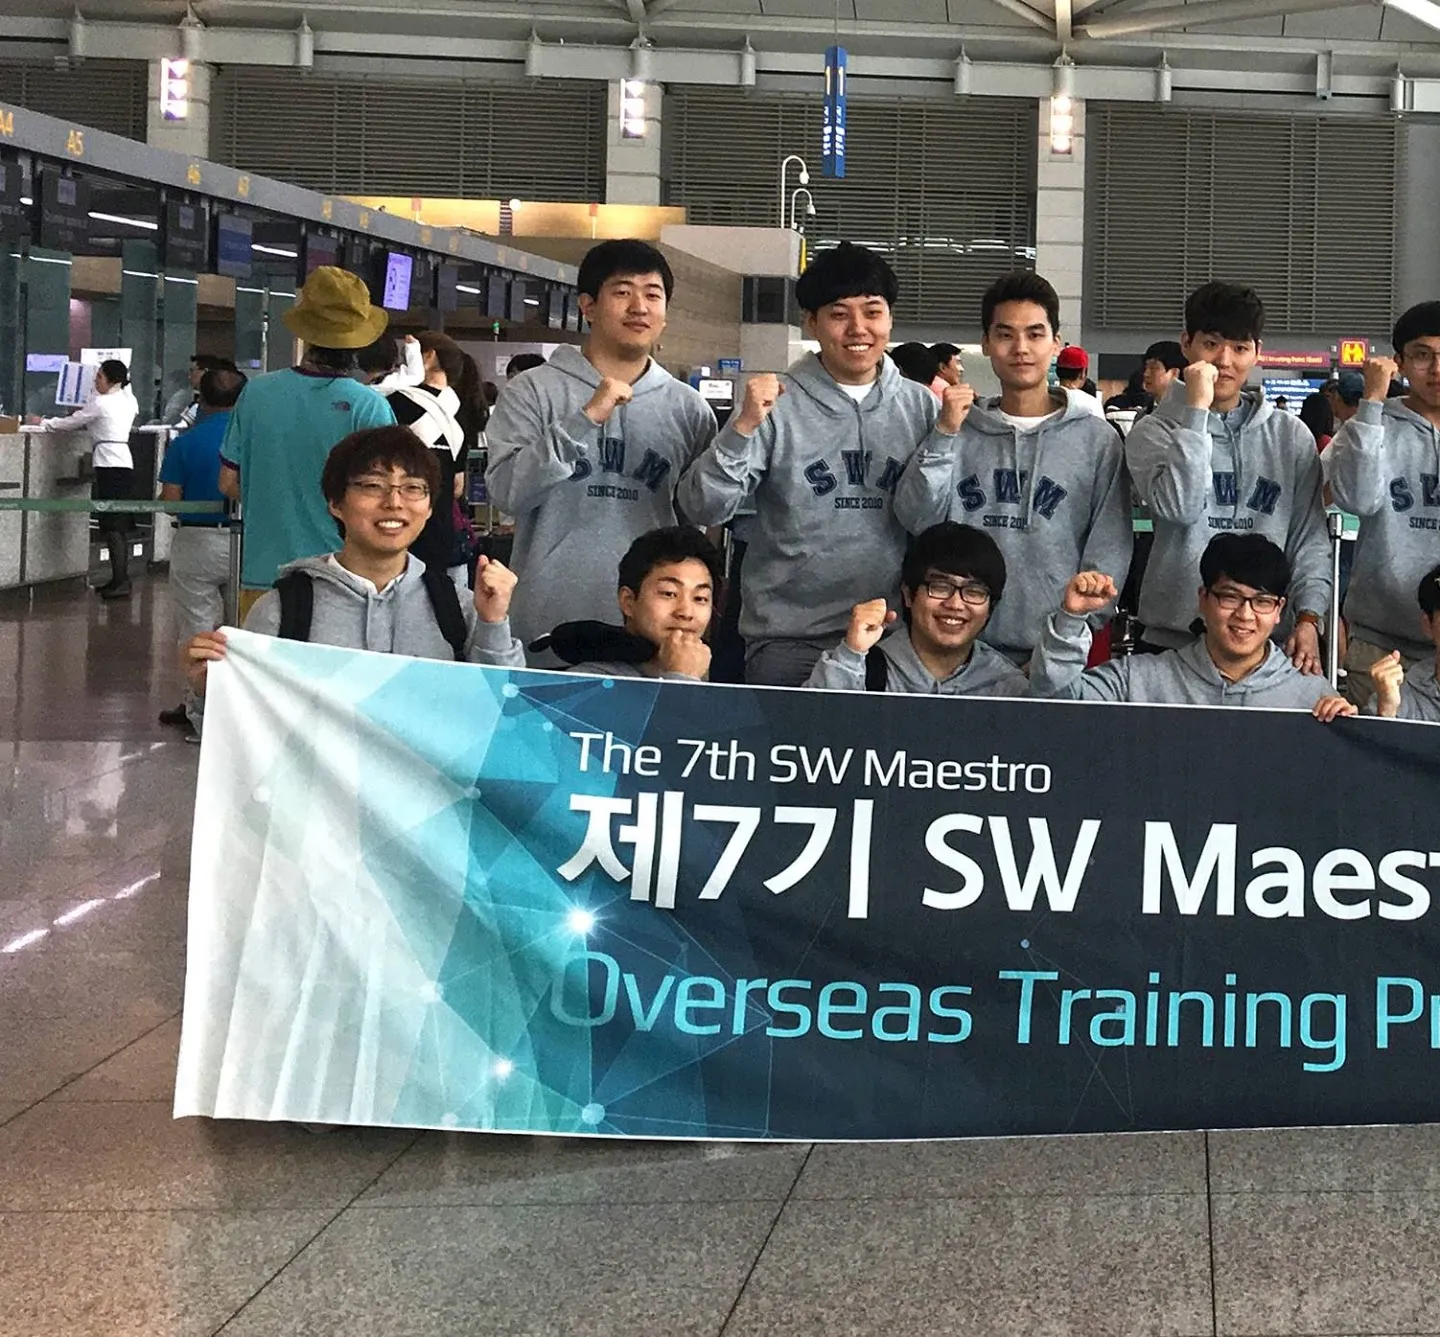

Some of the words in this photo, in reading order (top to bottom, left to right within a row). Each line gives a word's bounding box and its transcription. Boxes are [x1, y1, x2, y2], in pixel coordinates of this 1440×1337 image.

[66, 129, 84, 156] A5
[587, 485, 617, 498] SINCE
[617, 486, 639, 501] 2010
[834, 497, 860, 509] SINCE
[861, 497, 883, 509] 2010
[982, 514, 1009, 527] SINCE
[1207, 516, 1233, 529] SINCE
[1409, 516, 1438, 530] SINCE
[570, 731, 661, 777] The
[676, 738, 756, 781] 7th
[769, 745, 853, 785] SW
[864, 749, 1052, 793] Maestro
[556, 790, 874, 919] 제7기
[921, 812, 1101, 912] SW
[551, 950, 973, 1044] Overseas
[999, 969, 1347, 1073] Training
